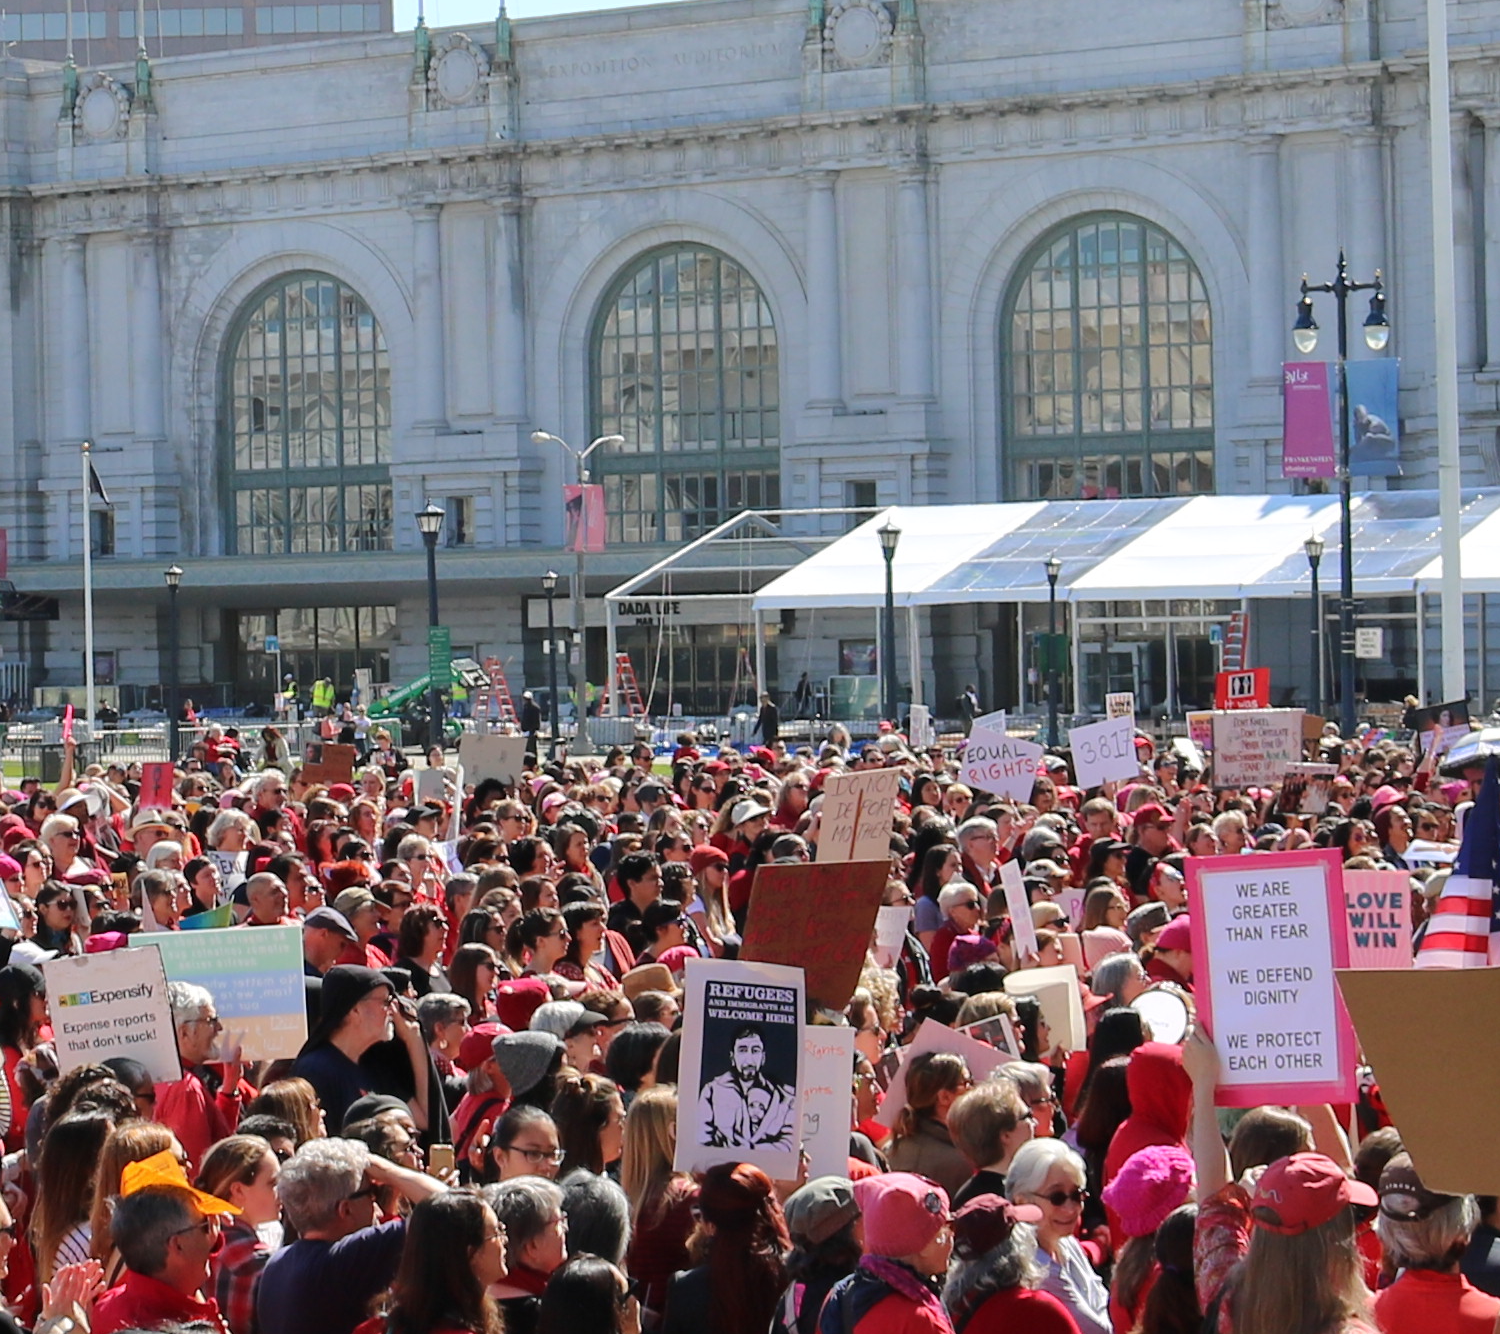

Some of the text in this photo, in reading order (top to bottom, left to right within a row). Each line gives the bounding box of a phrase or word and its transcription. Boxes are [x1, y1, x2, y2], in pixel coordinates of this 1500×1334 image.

[549, 43, 784, 78] EXPOSITION AUDITORIUM
[619, 601, 681, 616] DADA LIFE
[967, 743, 1026, 764] EQUAL
[1081, 728, 1130, 764] 3.817
[969, 758, 1036, 784] RIGHTS
[834, 774, 896, 797] DO NOT
[1236, 881, 1291, 898] WE ARE
[1346, 893, 1402, 909] LOVE
[1232, 903, 1298, 919] GREATER
[1349, 913, 1402, 928] WILL
[1226, 924, 1309, 941] THAN FEAR
[1354, 932, 1397, 948] WIN
[1228, 967, 1313, 984] WE DEFEND
[90, 982, 154, 1005] Expensify
[709, 983, 794, 1003] REFUGEES
[1245, 990, 1299, 1005] DIGNITY
[708, 998, 794, 1013] AND IMMIGRANTS ARE
[63, 1012, 156, 1035] Expense reports
[708, 1008, 794, 1024] WELCOME HERE
[68, 1029, 156, 1051] that don't suck!
[1227, 1031, 1322, 1048] WE PROTECT
[1229, 1053, 1322, 1070] EACH OTHER
